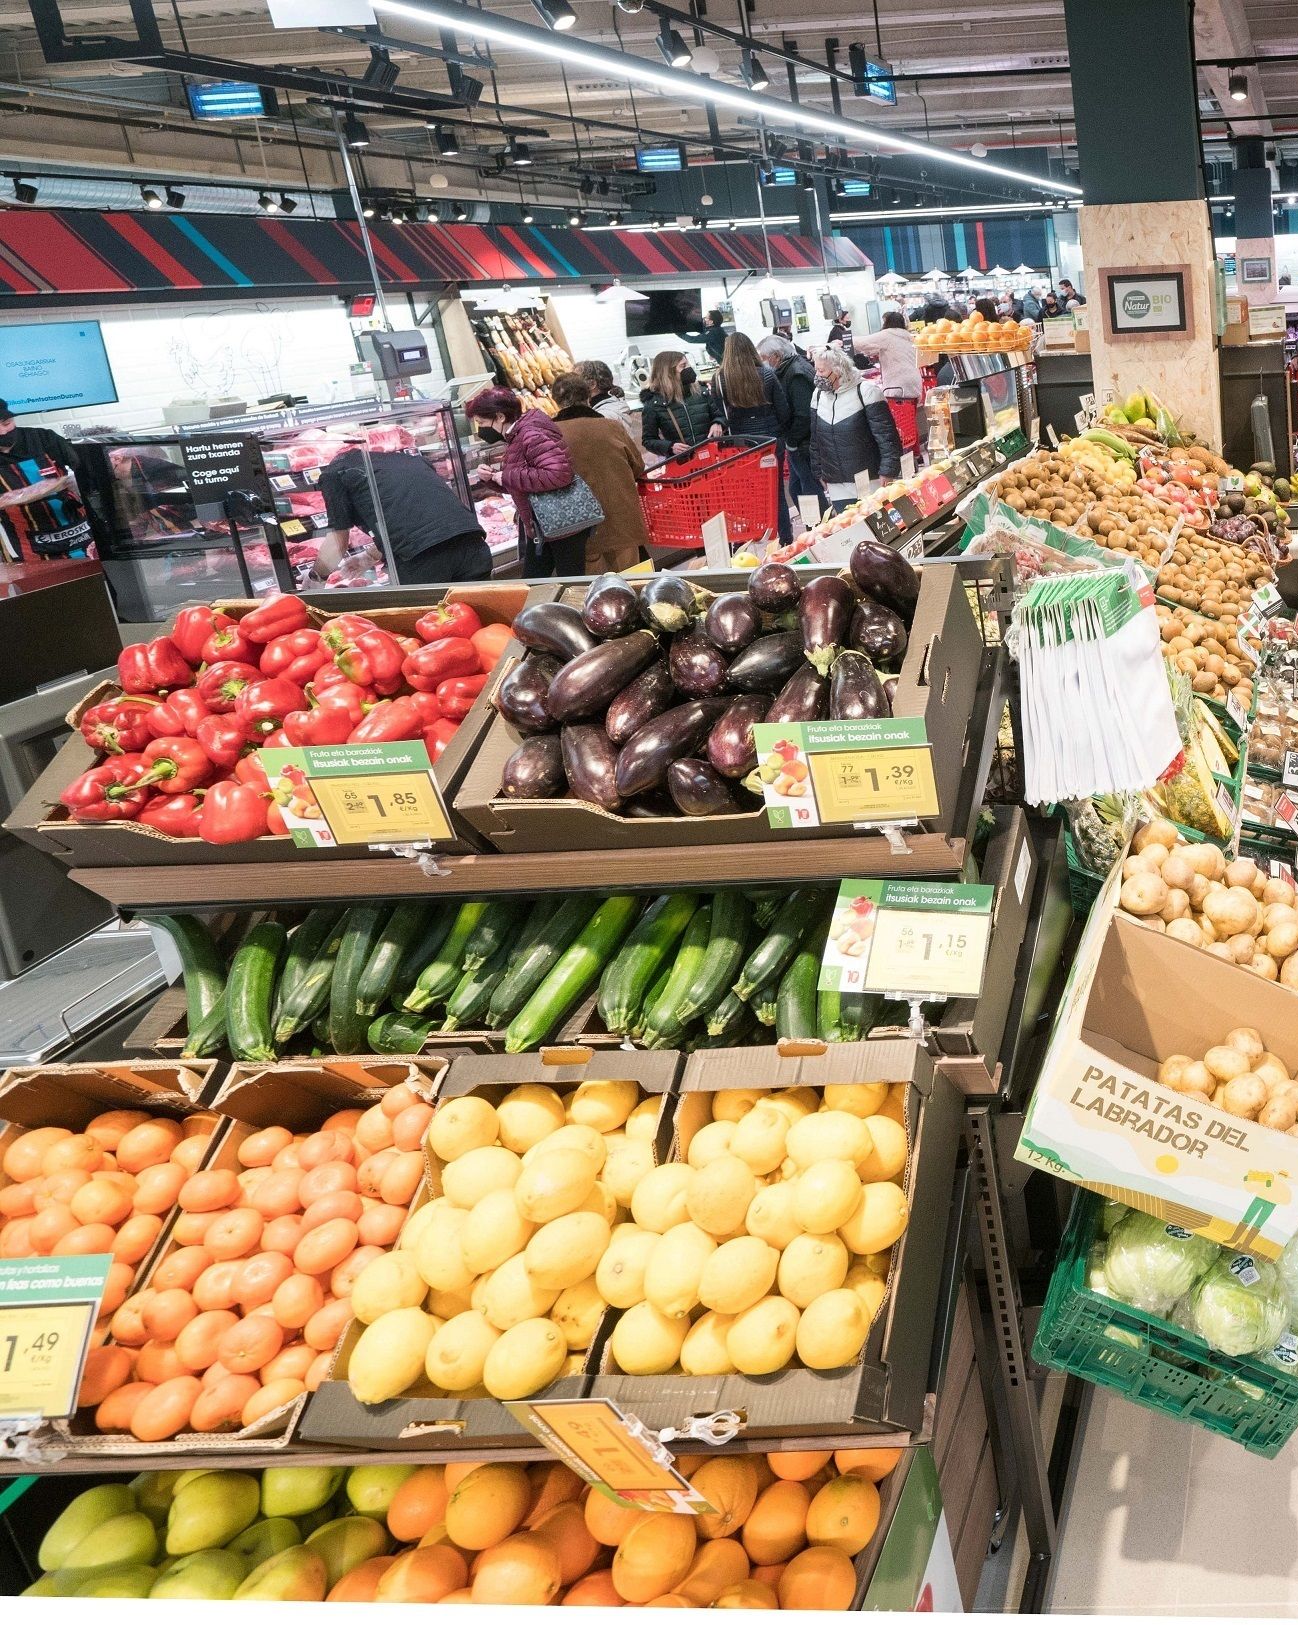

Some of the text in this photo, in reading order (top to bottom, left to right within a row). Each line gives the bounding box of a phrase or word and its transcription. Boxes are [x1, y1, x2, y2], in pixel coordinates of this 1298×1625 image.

[1124, 300, 1150, 311] Natur
[1152, 294, 1172, 305] BIO
[186, 441, 244, 453] Hartu hemen
[187, 449, 240, 461] zure txanda
[192, 465, 240, 478] Coge aquí
[193, 475, 229, 486] tu turno
[53, 523, 89, 540] EROSKI
[807, 725, 828, 733] Fruta
[843, 723, 882, 732] barazkiak
[847, 732, 882, 742] bezain
[884, 731, 910, 741] onak
[310, 748, 384, 758] Fruta eta barazkiak
[350, 757, 385, 767] bezain
[386, 754, 413, 764] onak
[841, 765, 854, 773] 77
[864, 765, 915, 791] 1,39
[344, 792, 358, 800] 65
[367, 793, 417, 817] 1,85
[887, 885, 906, 893] Fruta
[920, 886, 955, 895] barazkiak
[886, 894, 977, 907] itsusiak bezain onak
[901, 927, 914, 936] 56
[921, 933, 967, 961] 1,15
[1082, 1064, 1250, 1153] PATATAS DEL
[1069, 1087, 1209, 1159] LABRADOR
[1027, 1149, 1066, 1174] 12 Kg.
[22, 1263, 60, 1274] hortalizas
[7, 1278, 30, 1291] feas
[30, 1277, 62, 1290] como
[64, 1275, 104, 1288] buenas
[4, 1332, 60, 1373] 1,49
[527, 1413, 551, 1435] onak
